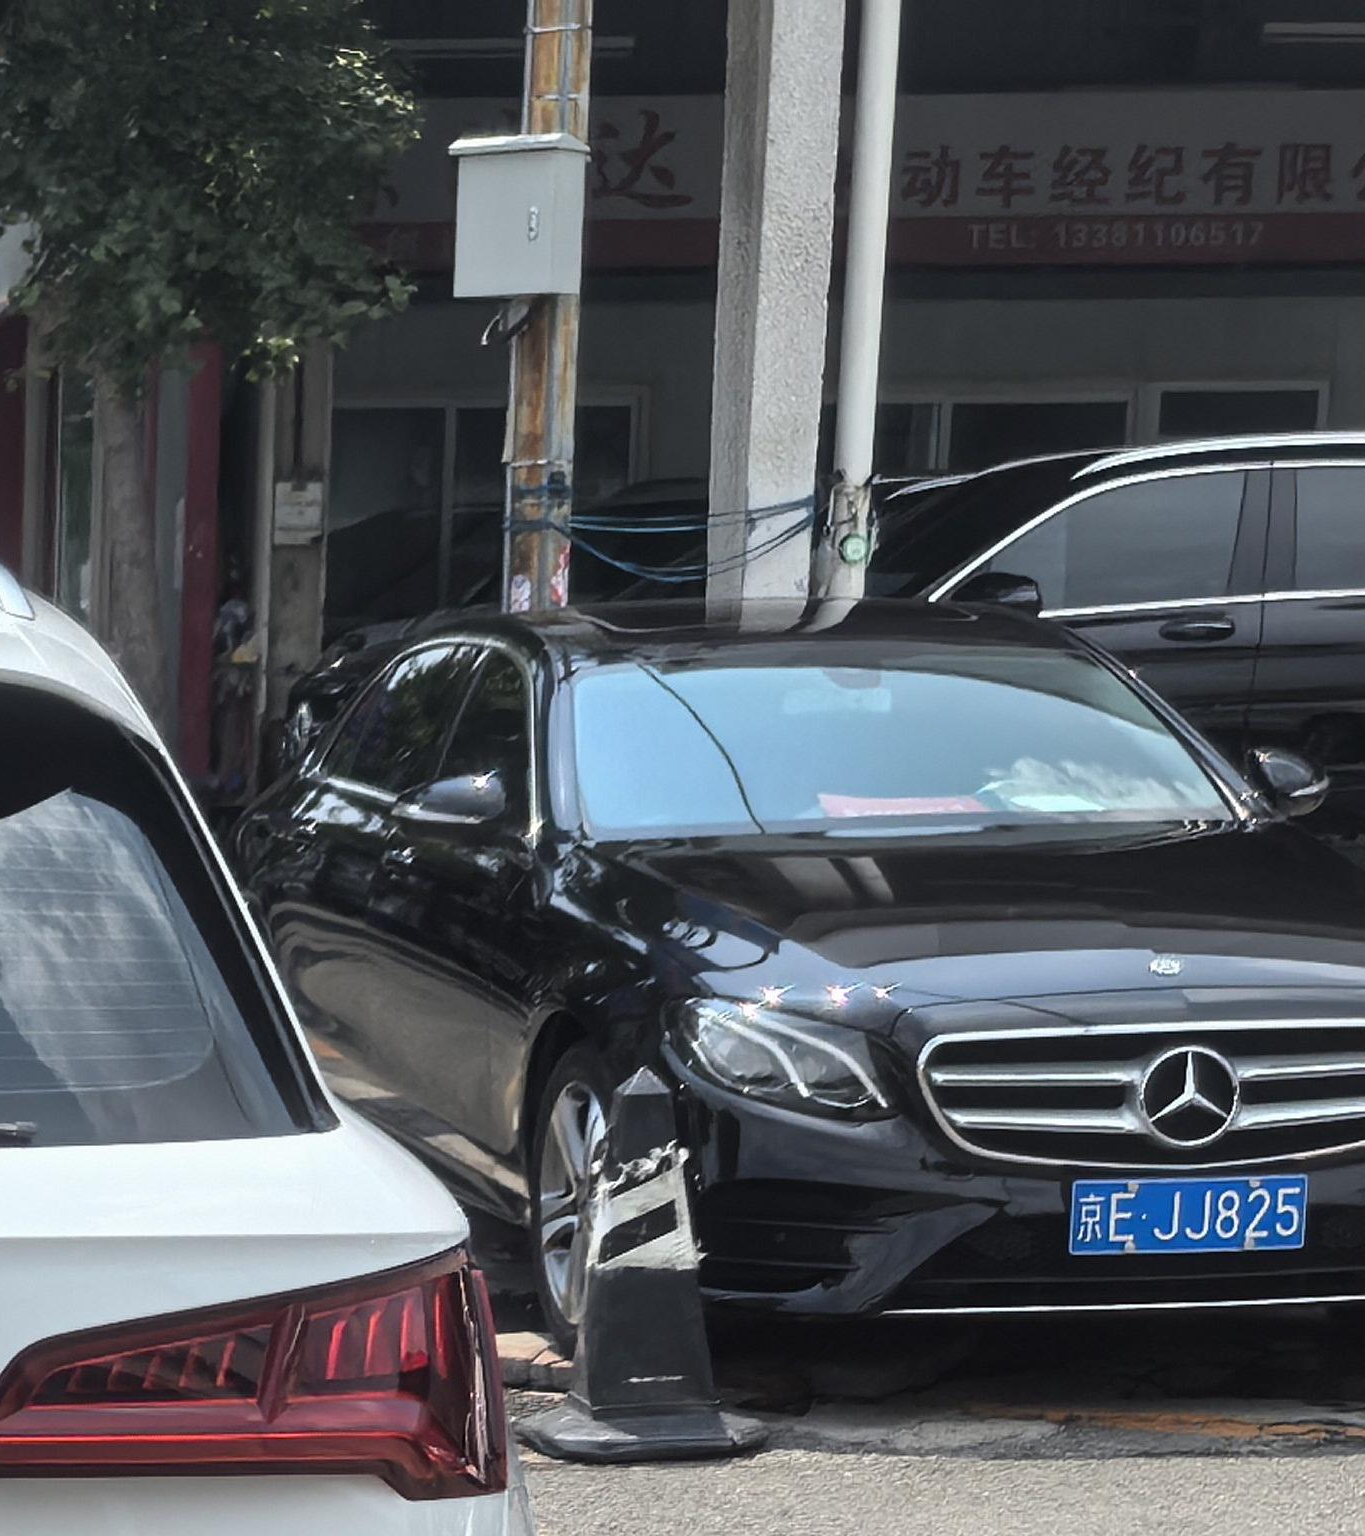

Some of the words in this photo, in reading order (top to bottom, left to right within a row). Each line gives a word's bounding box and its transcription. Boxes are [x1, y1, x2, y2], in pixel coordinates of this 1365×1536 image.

[900, 142, 1365, 207] 动车经纪有限
